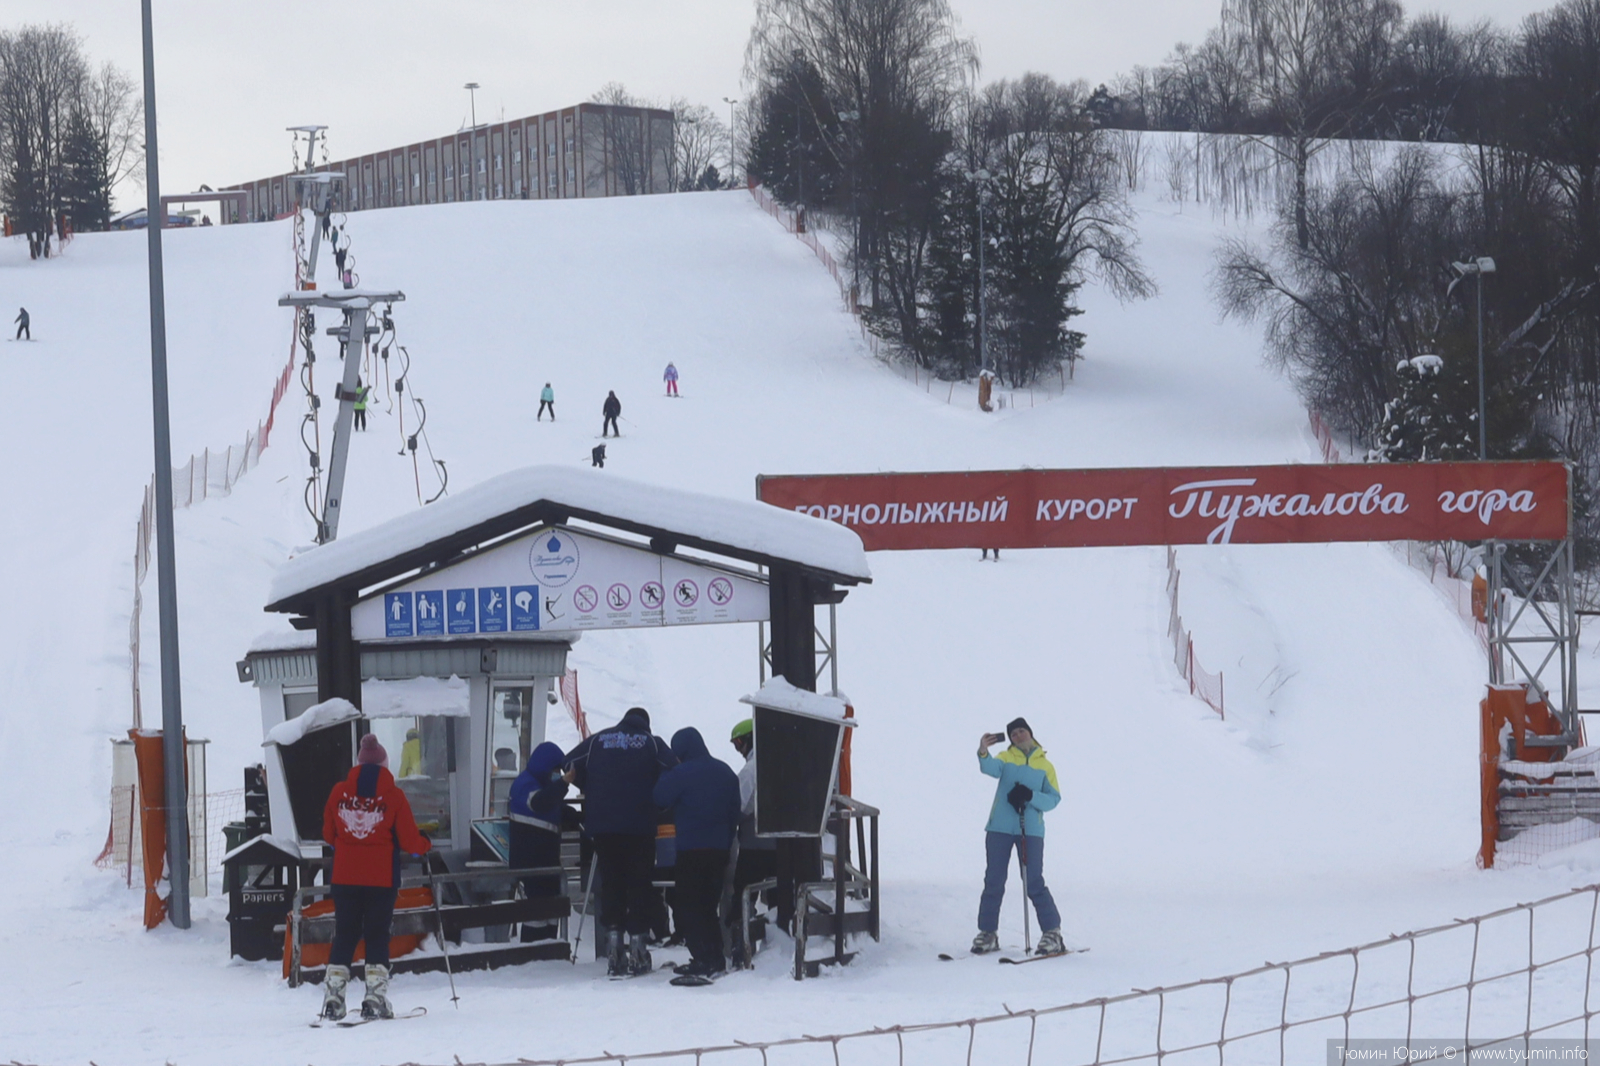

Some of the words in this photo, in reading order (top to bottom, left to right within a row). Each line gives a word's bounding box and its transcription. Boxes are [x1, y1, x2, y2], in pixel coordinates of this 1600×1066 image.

[1035, 497, 1138, 521] КУРОРТ
[1168, 478, 1409, 545] Пужалова
[1437, 489, 1537, 525] гора
